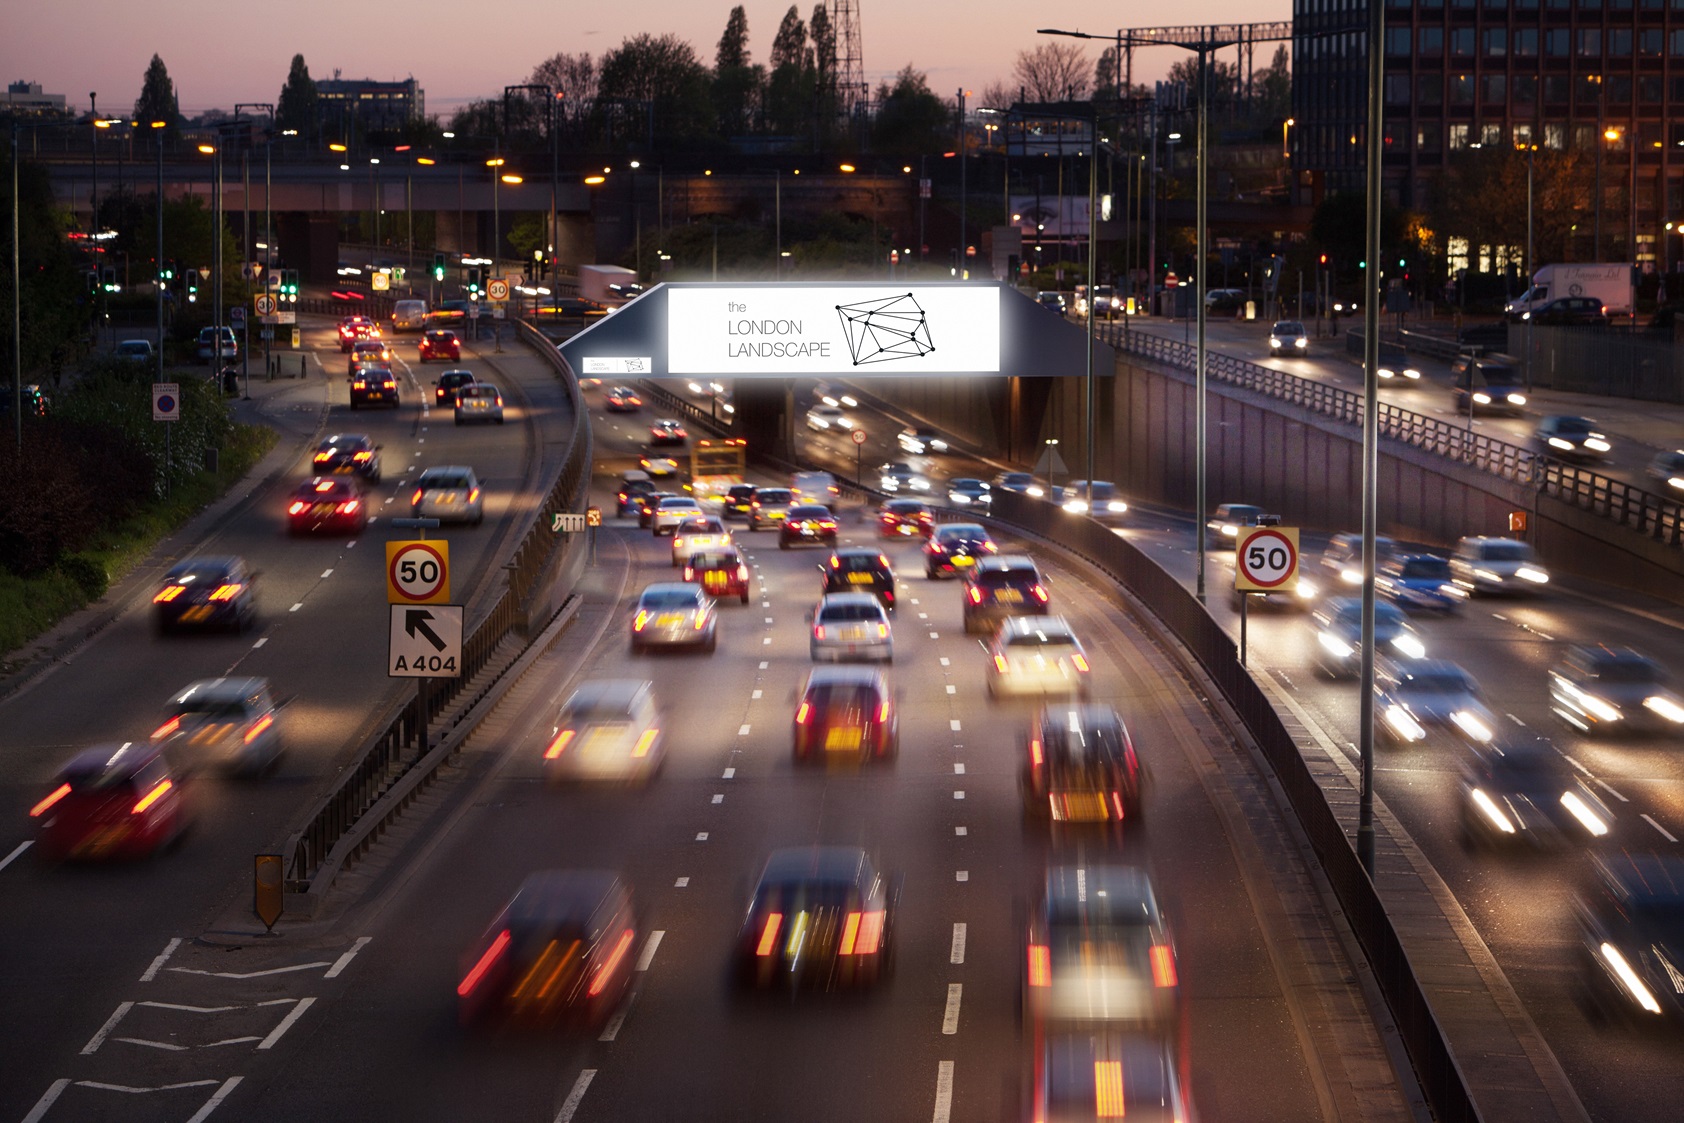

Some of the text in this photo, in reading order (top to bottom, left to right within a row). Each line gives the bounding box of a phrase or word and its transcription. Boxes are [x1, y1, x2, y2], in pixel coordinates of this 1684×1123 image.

[492, 286, 506, 294] 30
[259, 301, 272, 310] 30
[728, 301, 746, 312] the
[728, 319, 802, 335] LONDON
[728, 341, 831, 358] LANDSCAPE
[1248, 547, 1287, 571] 50
[400, 560, 438, 584] 50
